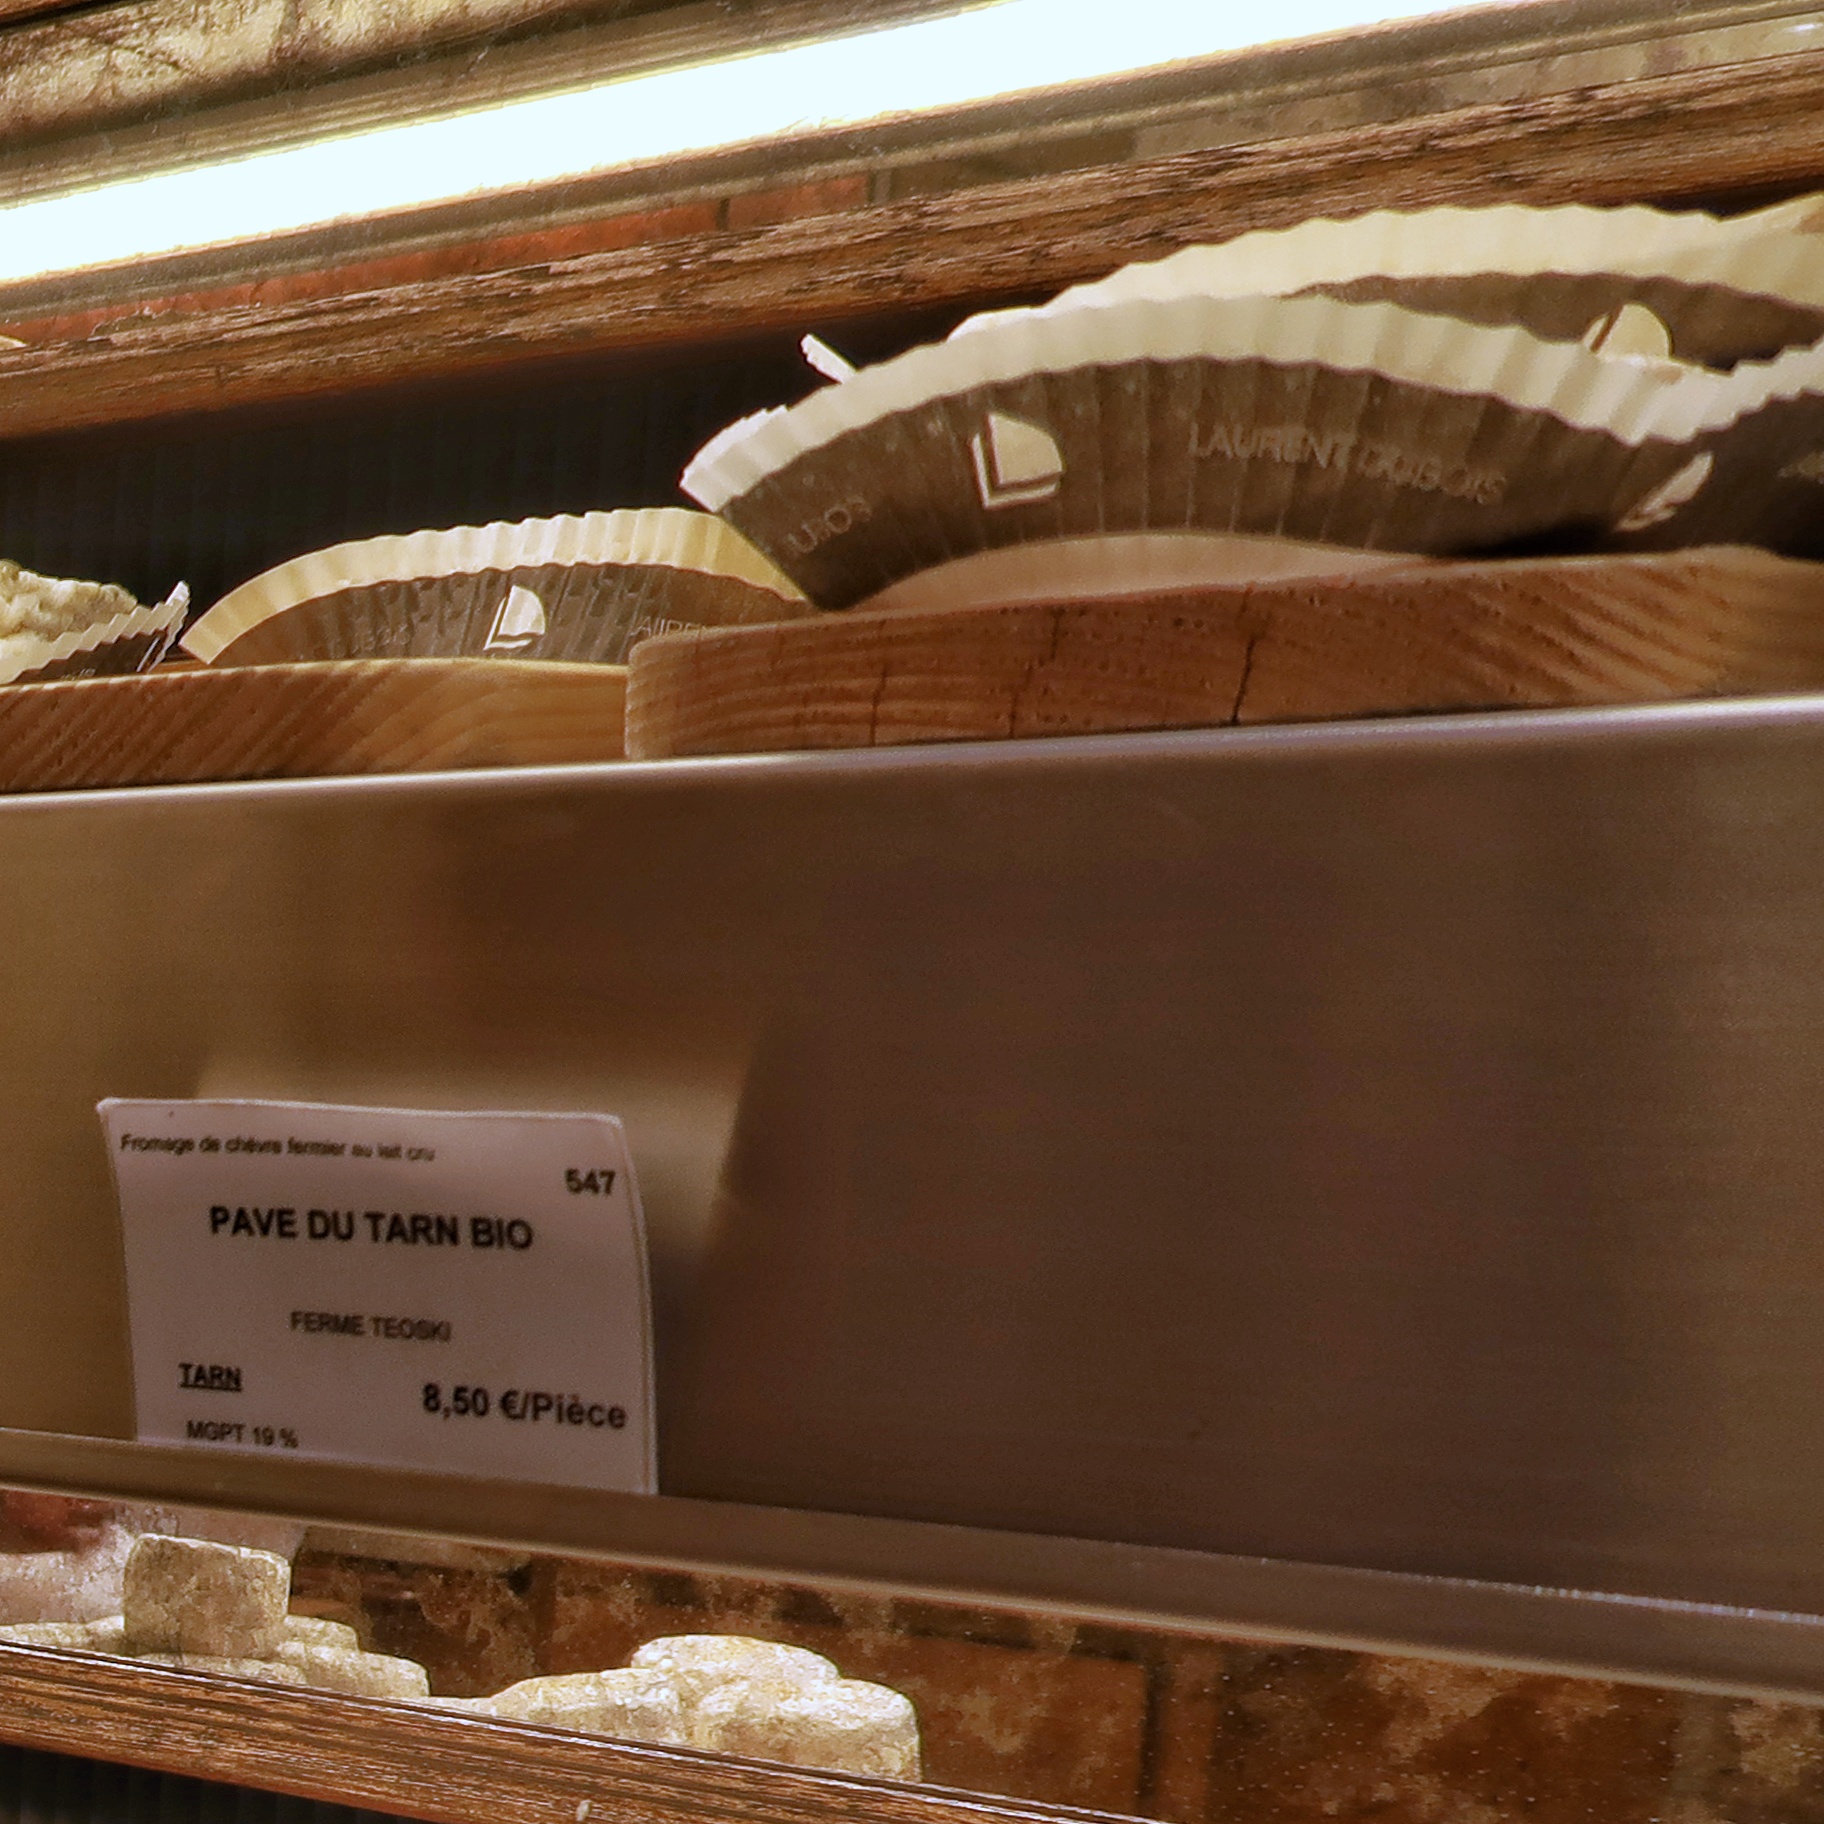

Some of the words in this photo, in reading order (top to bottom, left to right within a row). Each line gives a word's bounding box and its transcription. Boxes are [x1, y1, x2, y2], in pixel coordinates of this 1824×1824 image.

[120, 1132, 195, 1156] Fromage
[199, 1135, 222, 1154] de
[286, 1136, 346, 1157] fermier
[565, 1168, 616, 1196] 547
[210, 1206, 298, 1241] PAVE
[308, 1209, 354, 1242] DU
[364, 1211, 459, 1248] TARN
[470, 1216, 534, 1251] BIO
[290, 1310, 365, 1338] FERME
[370, 1315, 453, 1343] TEOSKI
[178, 1361, 243, 1393] TARN
[422, 1383, 491, 1421] 8,50
[499, 1388, 628, 1431] €/Pièce
[186, 1419, 247, 1445] MGPT
